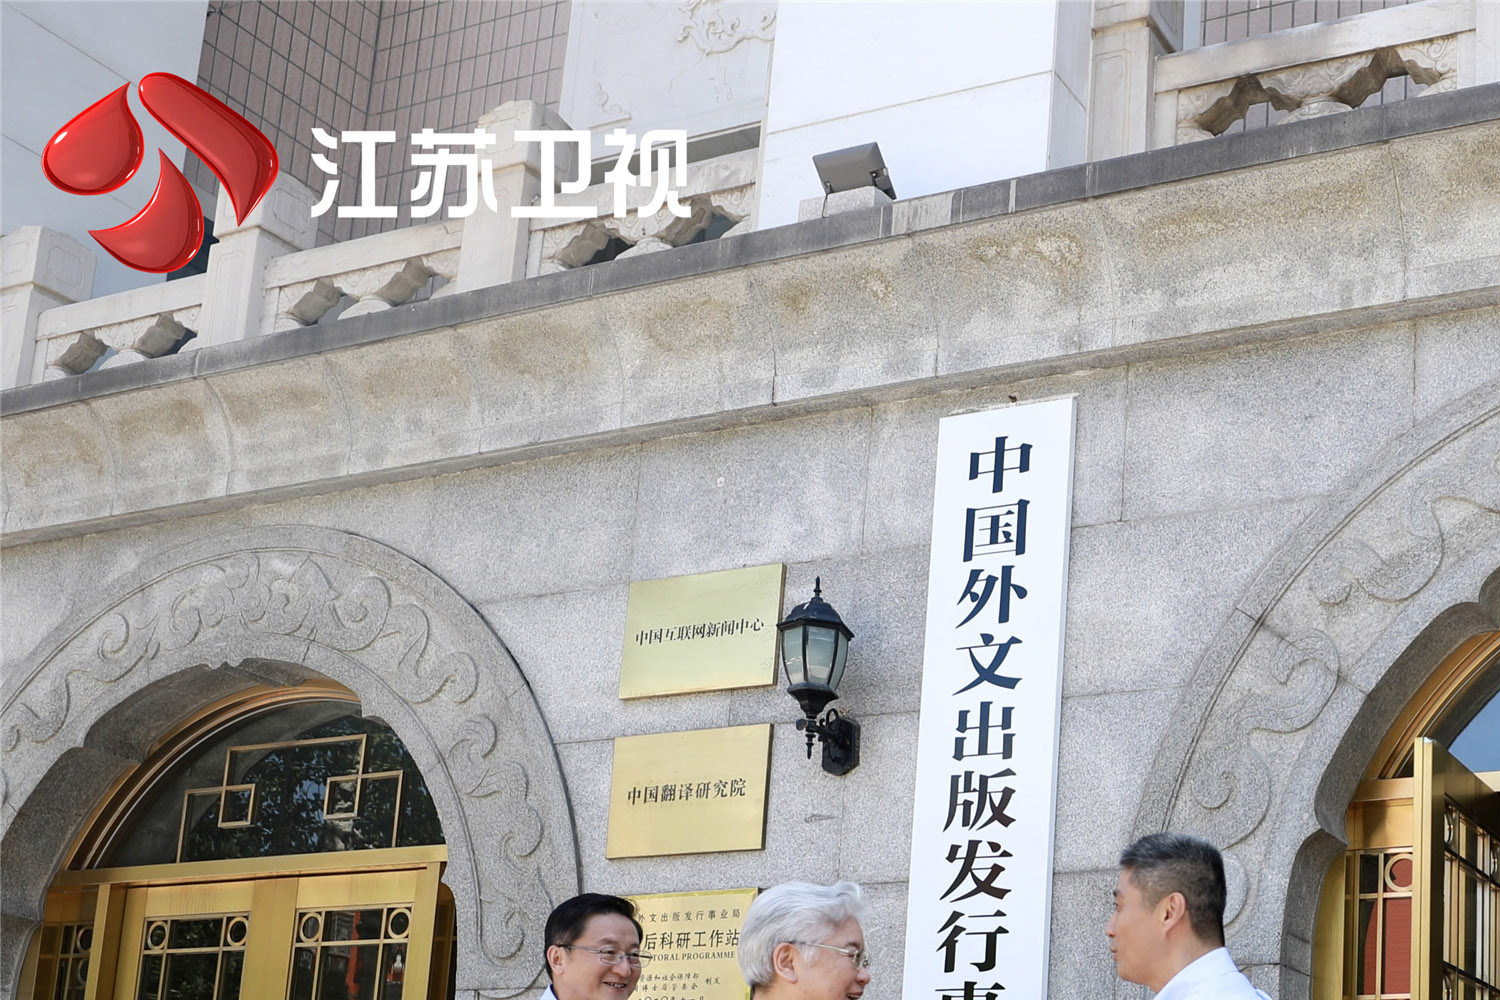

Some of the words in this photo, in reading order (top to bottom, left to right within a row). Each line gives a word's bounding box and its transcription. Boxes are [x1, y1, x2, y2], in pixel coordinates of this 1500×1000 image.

[635, 617, 764, 646] 中国互联网新闻中心
[627, 778, 747, 805] 中国翻译研究院
[681, 950, 736, 960] PROGRAMME
